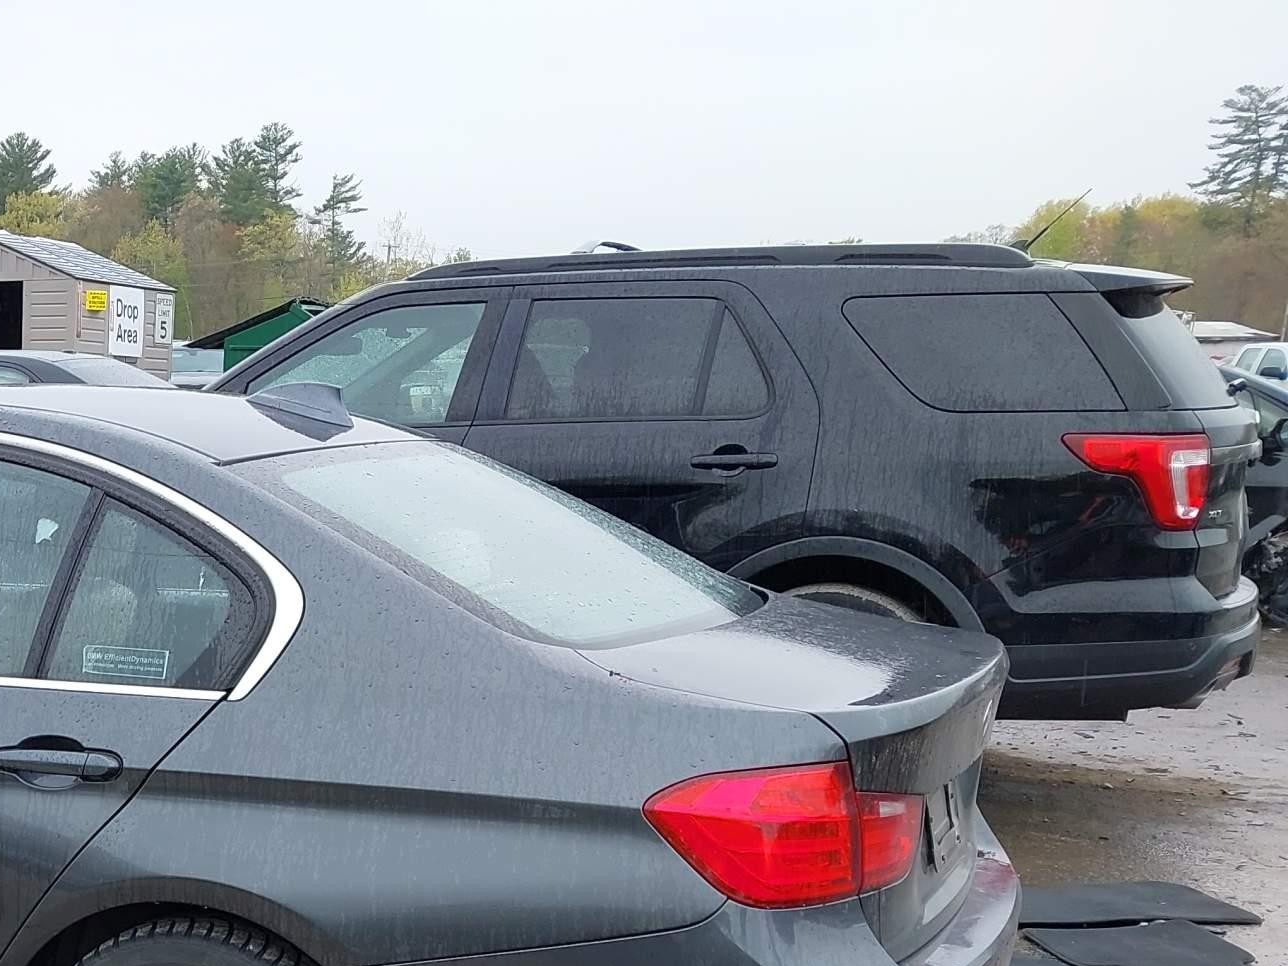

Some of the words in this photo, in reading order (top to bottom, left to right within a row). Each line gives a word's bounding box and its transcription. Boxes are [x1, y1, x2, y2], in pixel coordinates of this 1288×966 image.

[116, 298, 139, 323] Drop
[157, 297, 172, 307] SPEED
[158, 309, 171, 318] LIMIT
[115, 323, 138, 345] Area
[159, 320, 168, 340] 5
